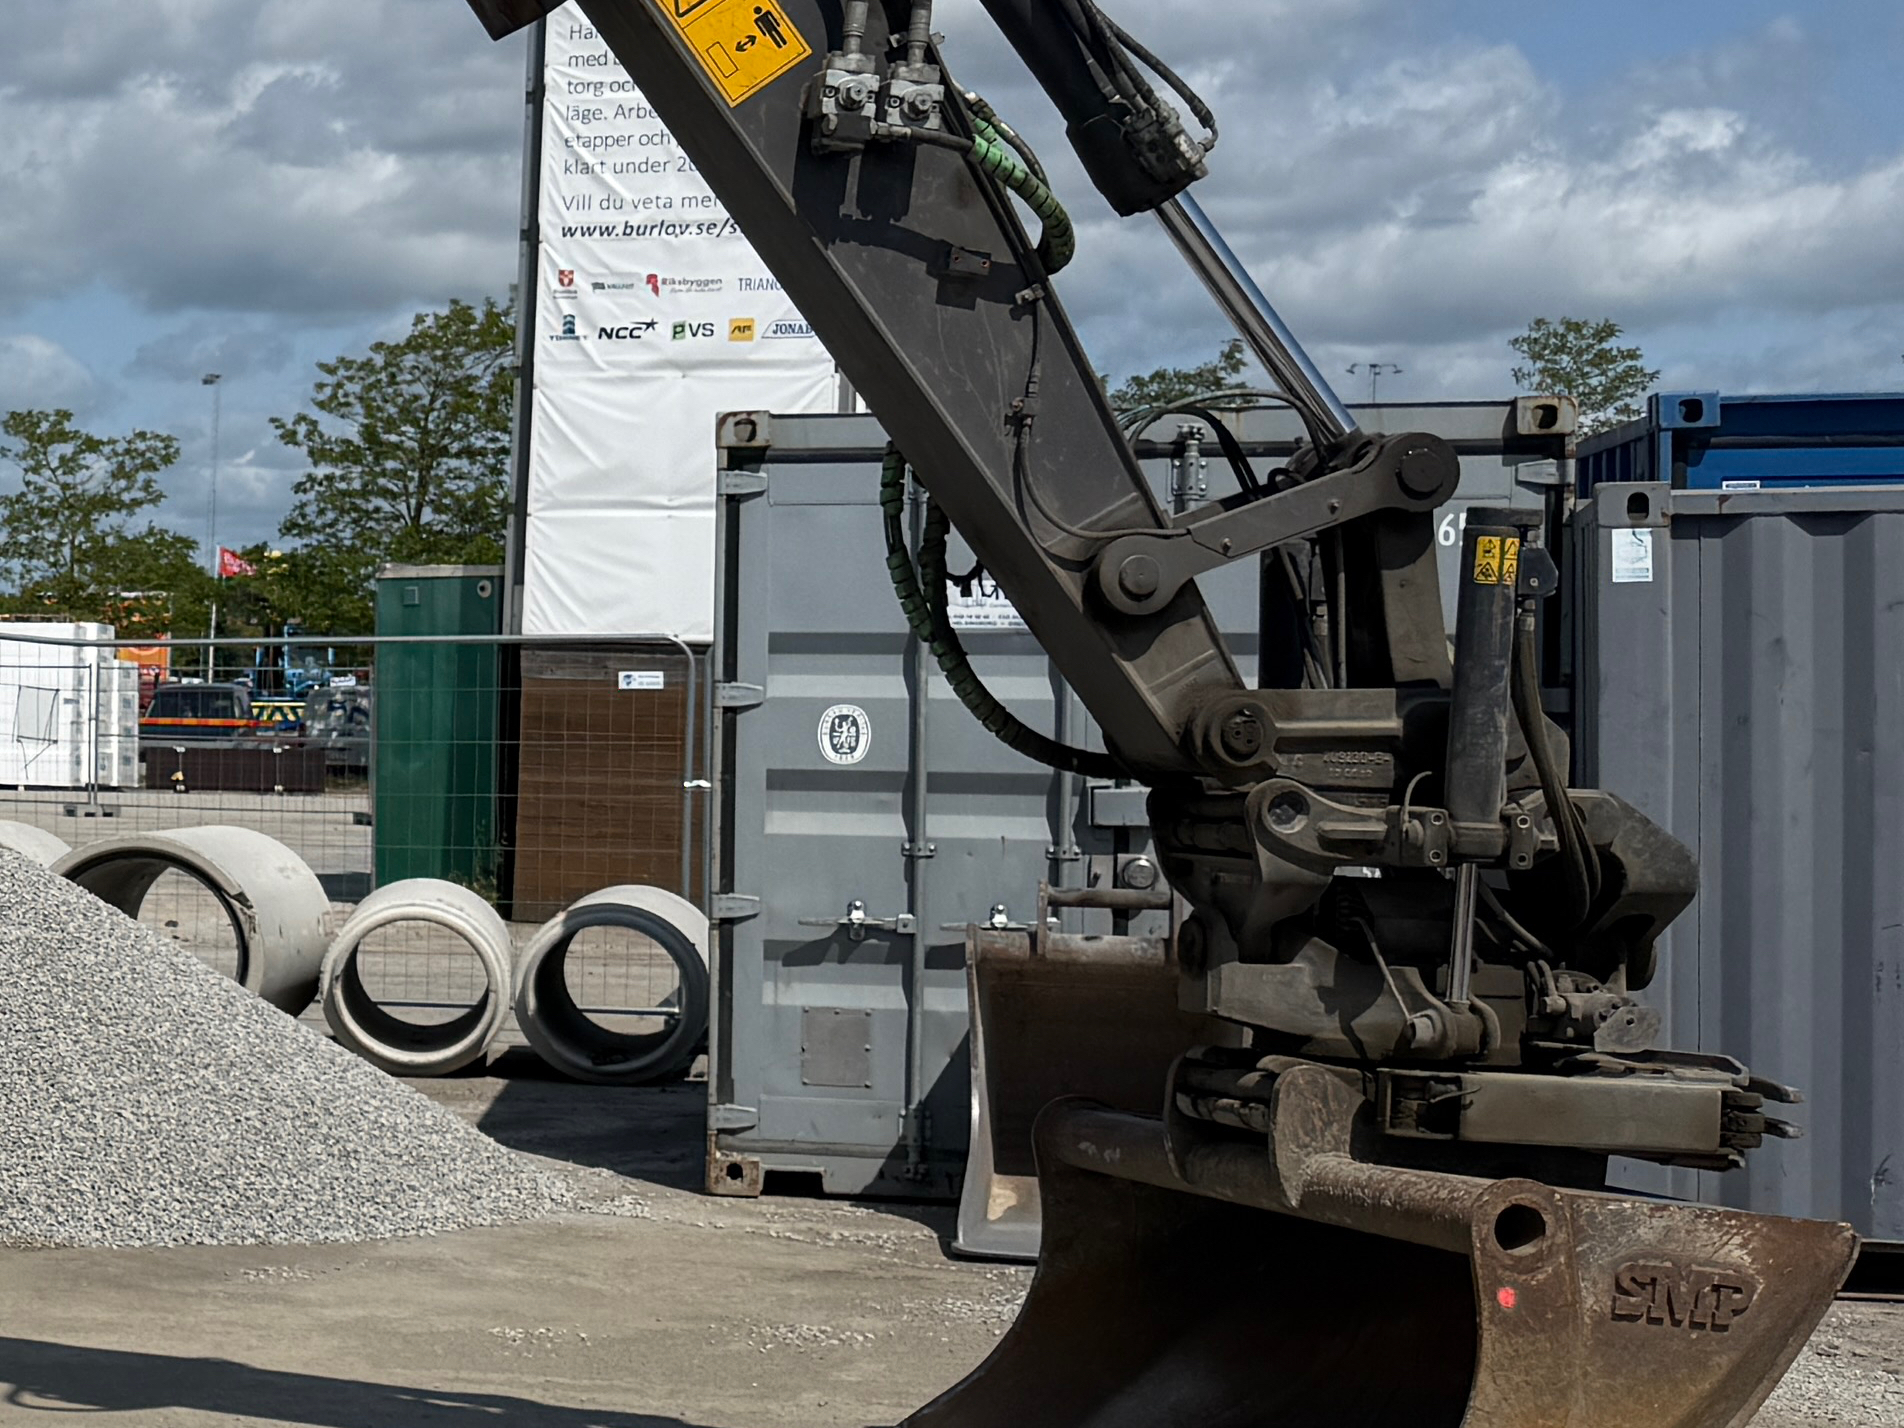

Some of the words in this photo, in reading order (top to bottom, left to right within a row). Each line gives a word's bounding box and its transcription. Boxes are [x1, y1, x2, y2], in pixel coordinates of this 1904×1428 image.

[569, 23, 598, 40] Ha
[568, 49, 608, 67] med
[567, 80, 604, 97] torg
[565, 104, 608, 125] läge.
[564, 134, 634, 152] etapper
[638, 129, 671, 146] och
[564, 158, 606, 175] klart
[613, 156, 670, 174] under
[562, 194, 592, 211] Vill
[599, 193, 624, 210] du
[632, 196, 673, 210] veta
[598, 327, 643, 340] NCC
[1610, 1261, 1759, 1333] SMP
